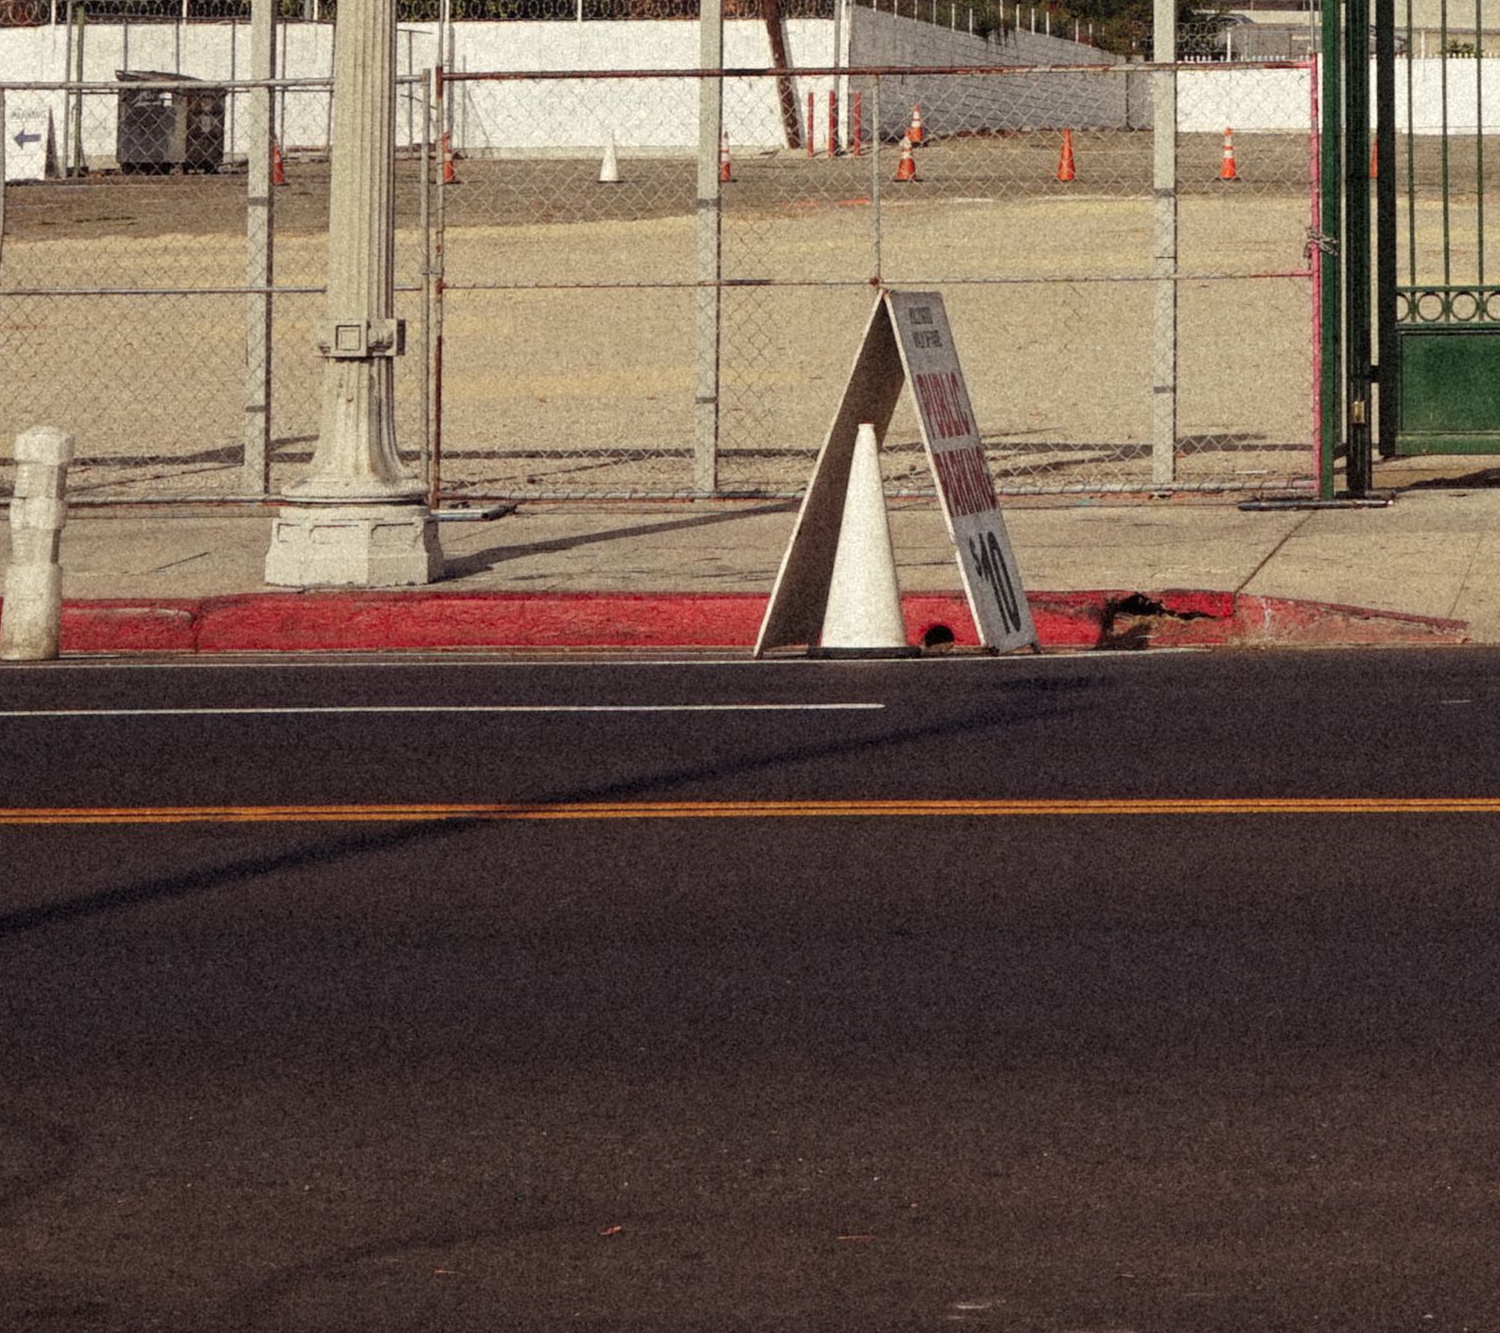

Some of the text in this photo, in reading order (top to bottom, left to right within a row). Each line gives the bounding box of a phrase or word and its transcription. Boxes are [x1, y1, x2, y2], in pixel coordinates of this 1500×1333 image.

[916, 370, 971, 440] PUBLIC
[933, 445, 997, 518] PARKING
[969, 531, 1022, 635] $10
